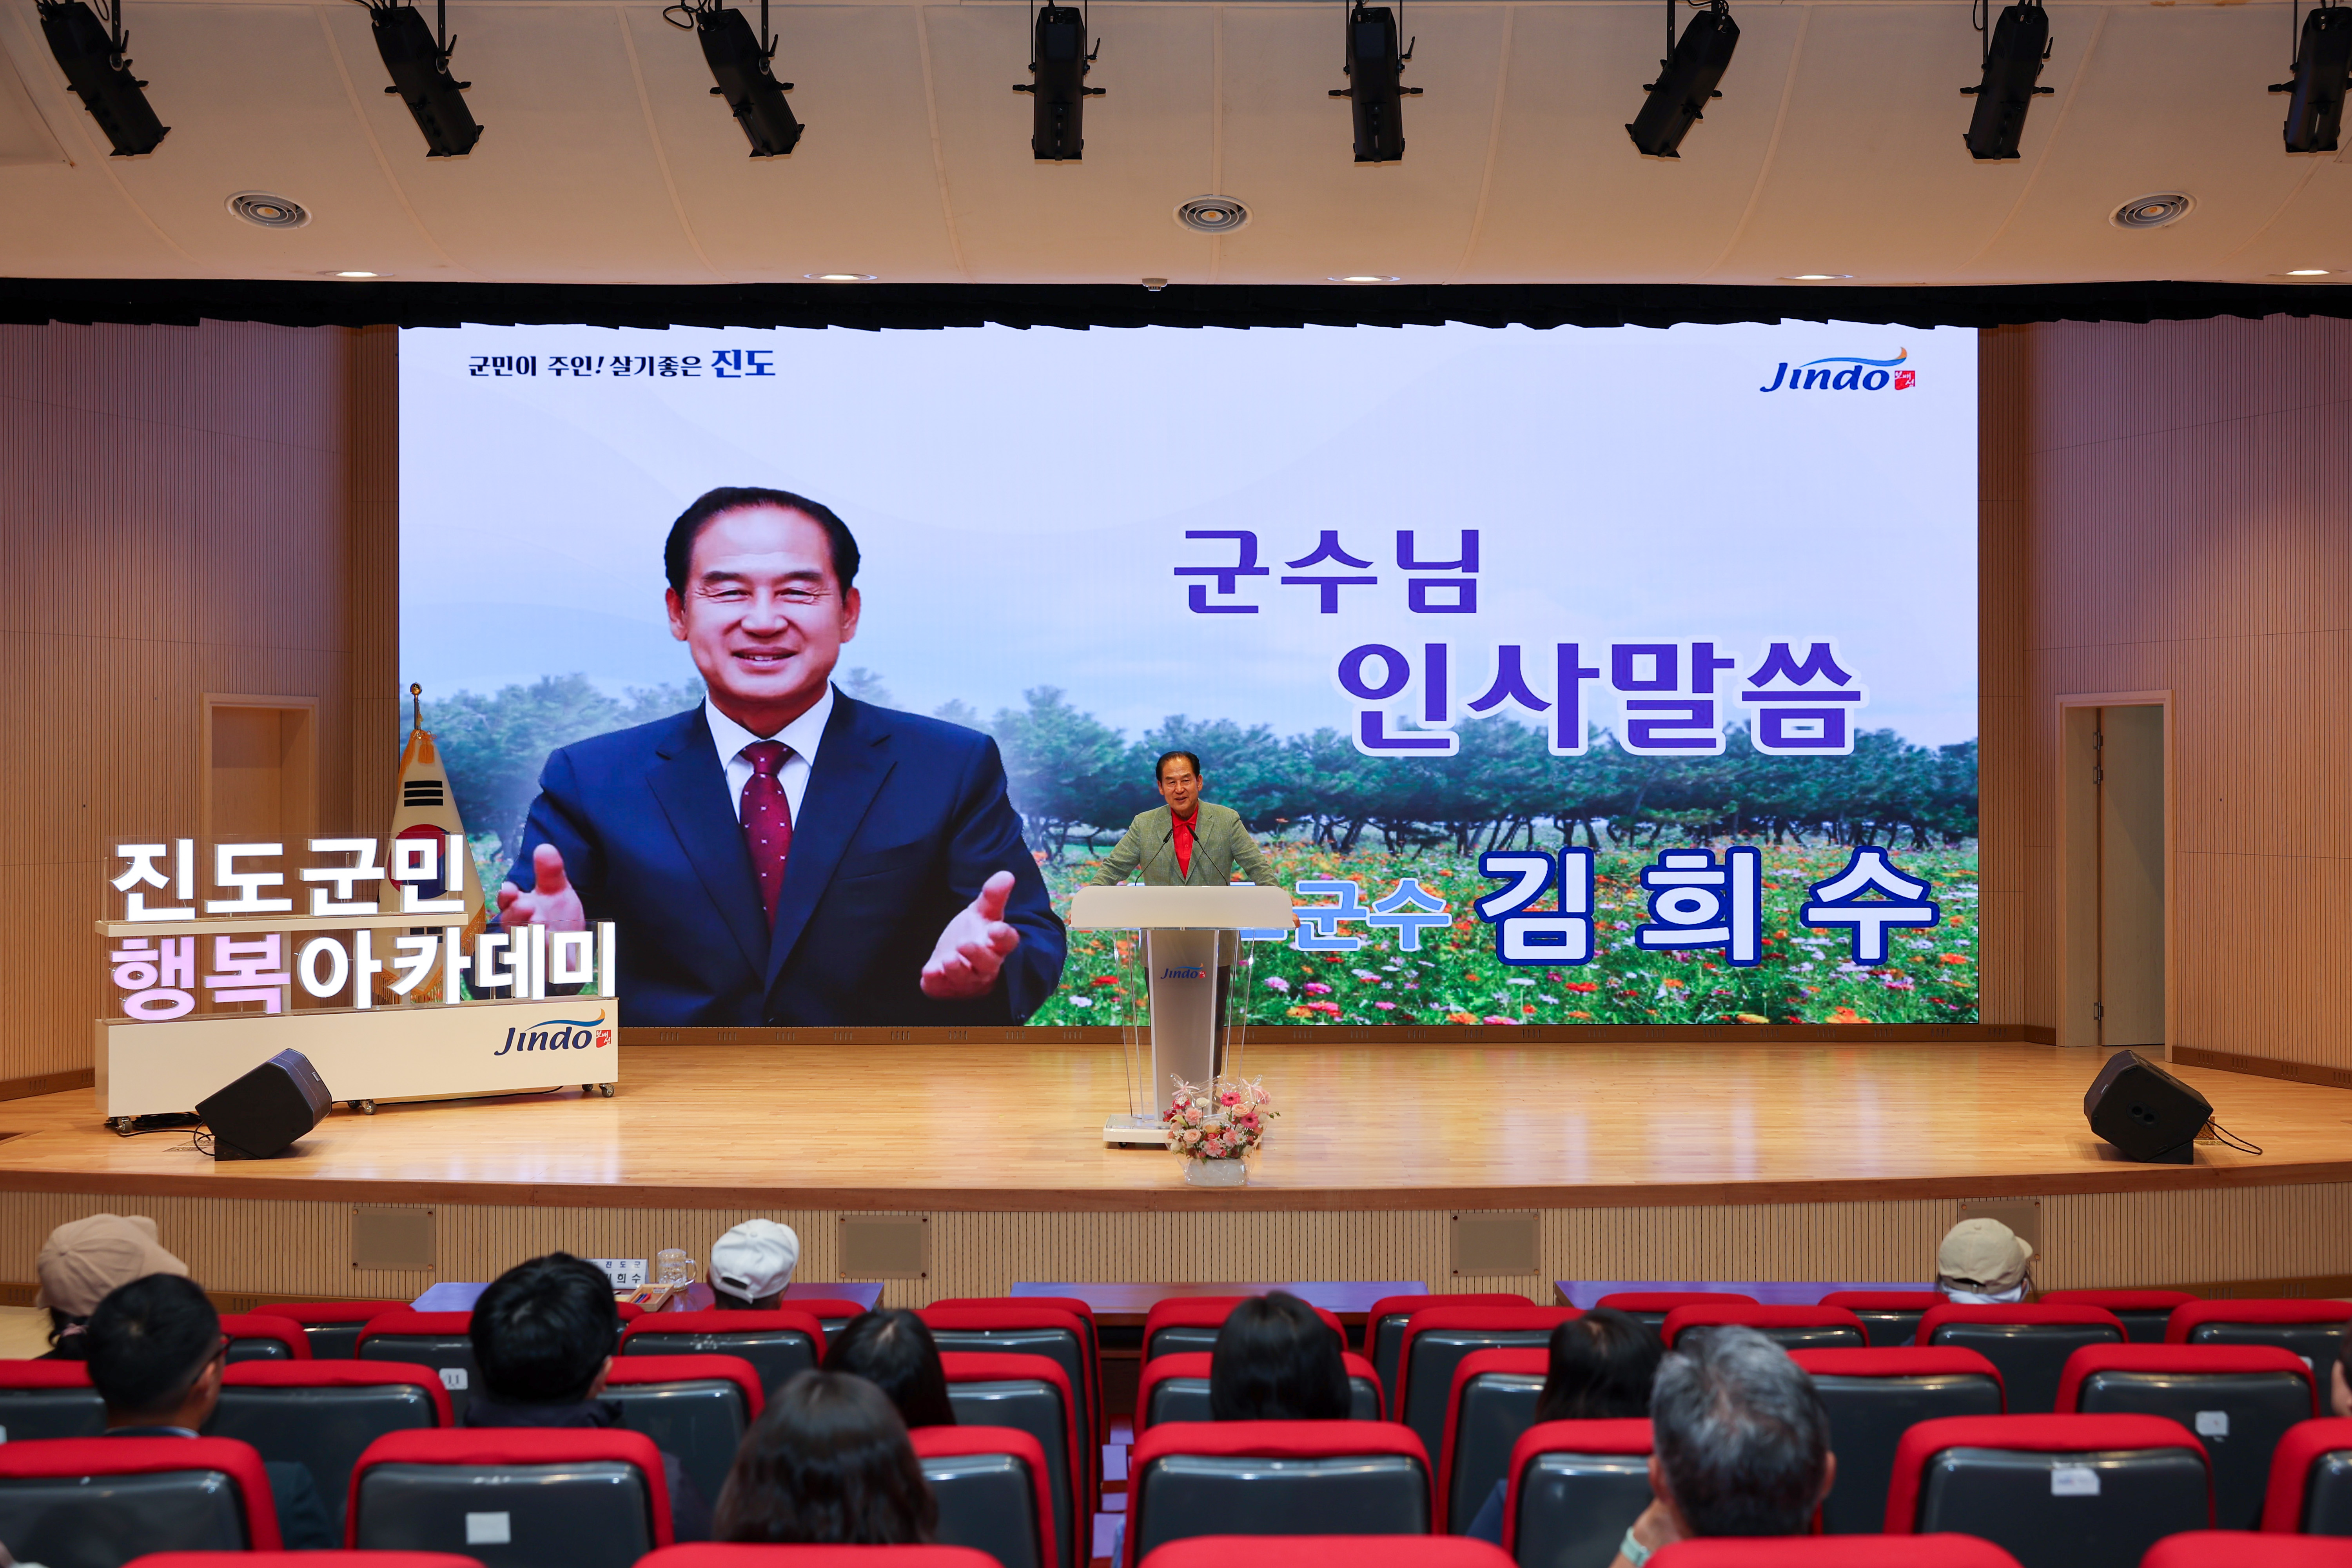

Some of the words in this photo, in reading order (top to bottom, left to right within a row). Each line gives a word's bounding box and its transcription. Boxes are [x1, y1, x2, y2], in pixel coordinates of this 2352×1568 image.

[468, 355, 537, 377] 군민이
[548, 356, 605, 377] 주인!
[610, 356, 702, 377] 살기좋은
[711, 349, 776, 378] 진도
[1760, 363, 1890, 392] Jindo
[1174, 529, 1479, 614] 군수님
[1338, 642, 1861, 749] 인사말씀
[111, 834, 465, 921] 진도군민
[1160, 968, 1198, 979] Jindo
[494, 1027, 592, 1055] Jindo
